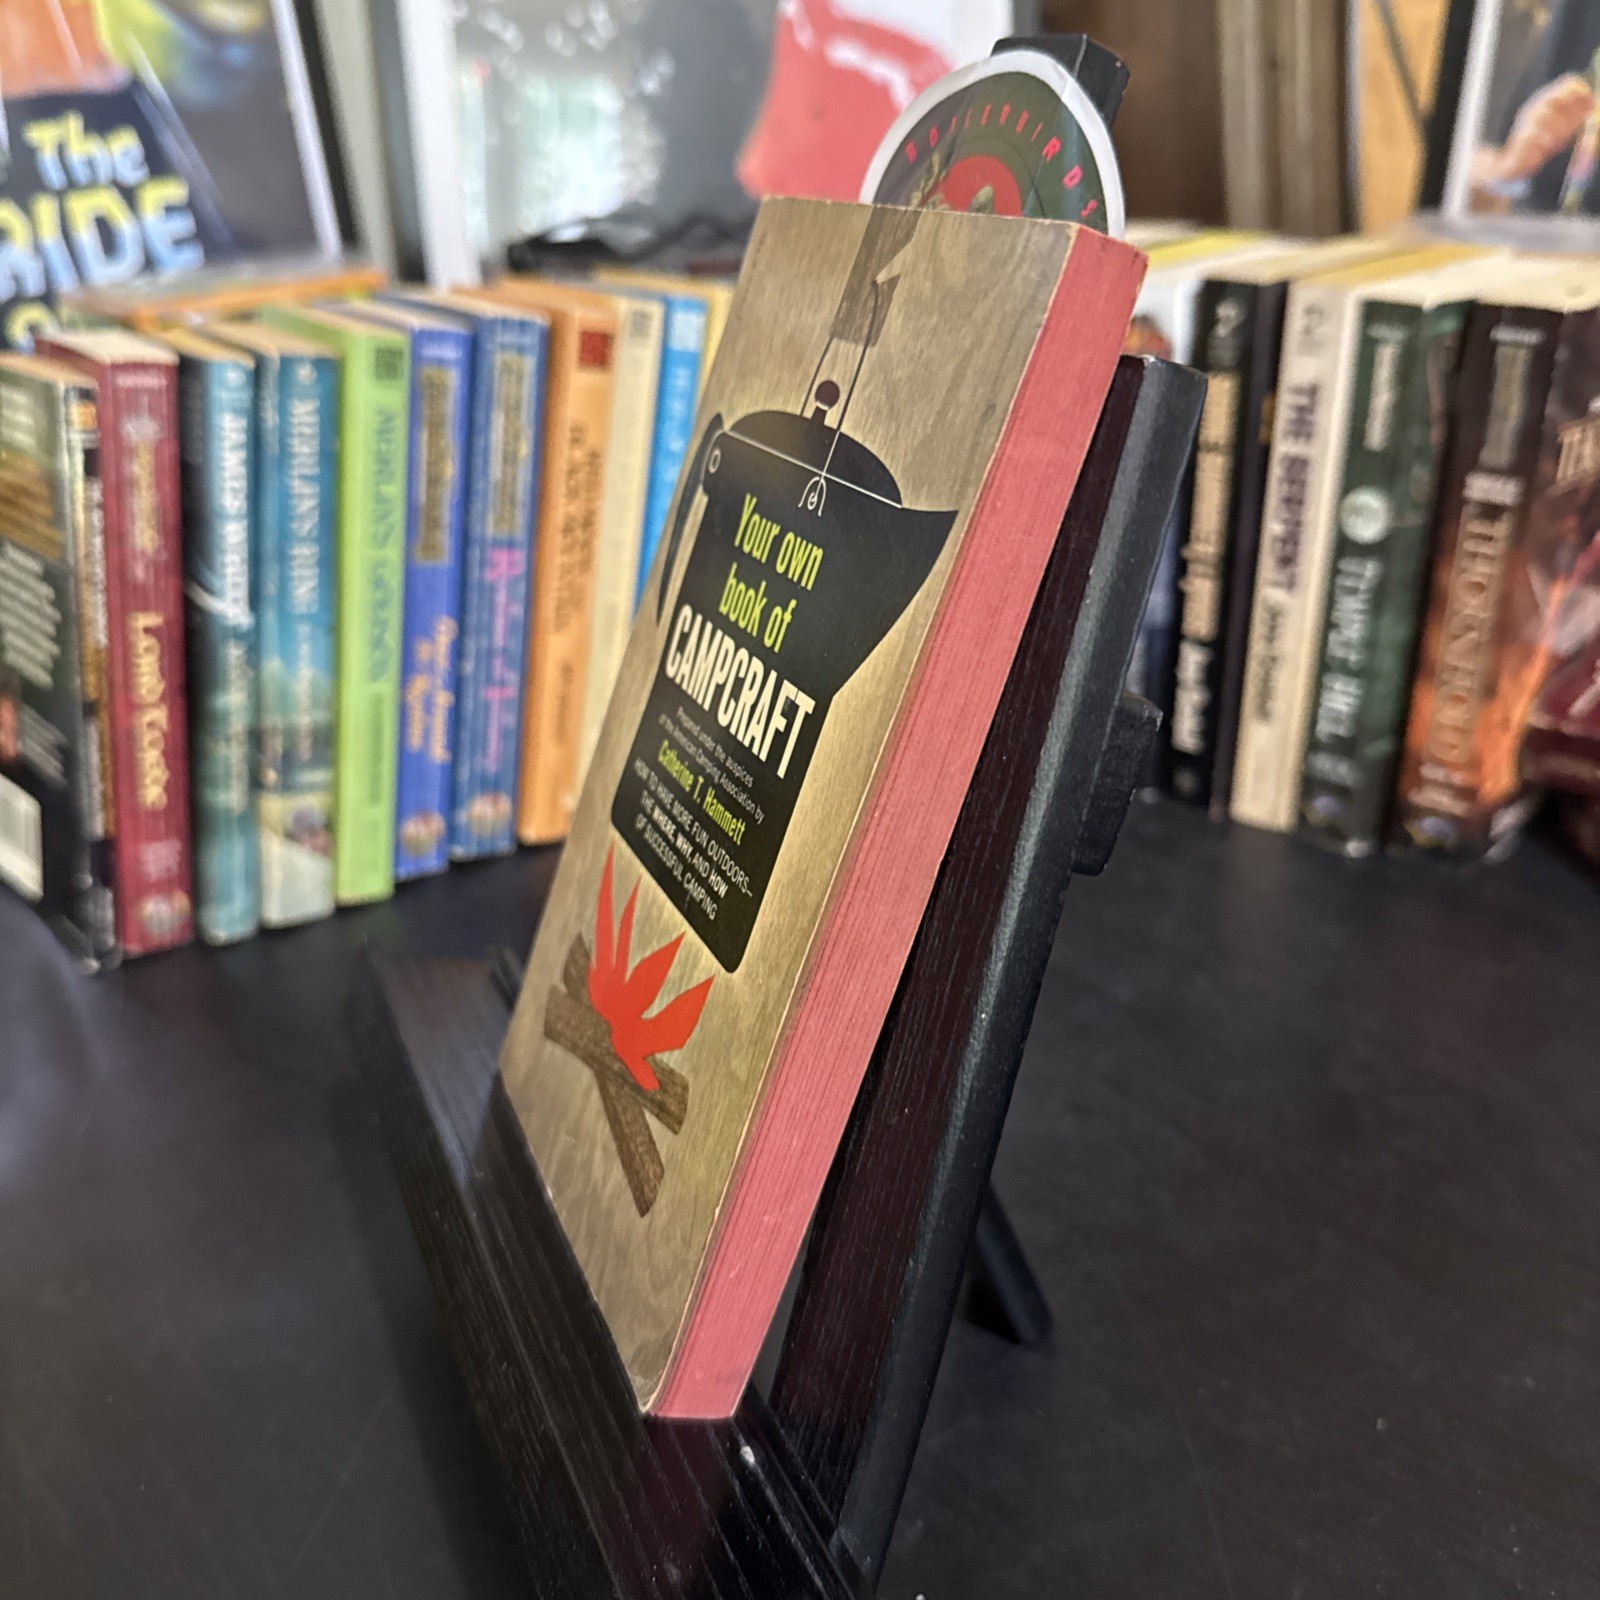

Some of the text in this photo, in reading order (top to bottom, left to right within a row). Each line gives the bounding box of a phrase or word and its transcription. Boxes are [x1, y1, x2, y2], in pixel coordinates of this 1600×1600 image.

[21, 109, 150, 191] The
[734, 492, 824, 591] Your own
[718, 561, 797, 653] book of
[665, 603, 816, 779] CAMPCRAFT
[658, 713, 765, 825] of the American Camping Association by
[658, 739, 746, 846] Catherine T. Hammett
[676, 705, 754, 788] Prepared under the auspices
[634, 757, 651, 782] HOW
[648, 771, 659, 791] TO
[656, 780, 675, 810] HAVE
[672, 800, 694, 832] MORE
[691, 821, 710, 849] FUN
[640, 790, 729, 898] THE WHERE, WHY, AND HOW
[634, 813, 718, 921] OF SUCCESSFUL CAMPING
